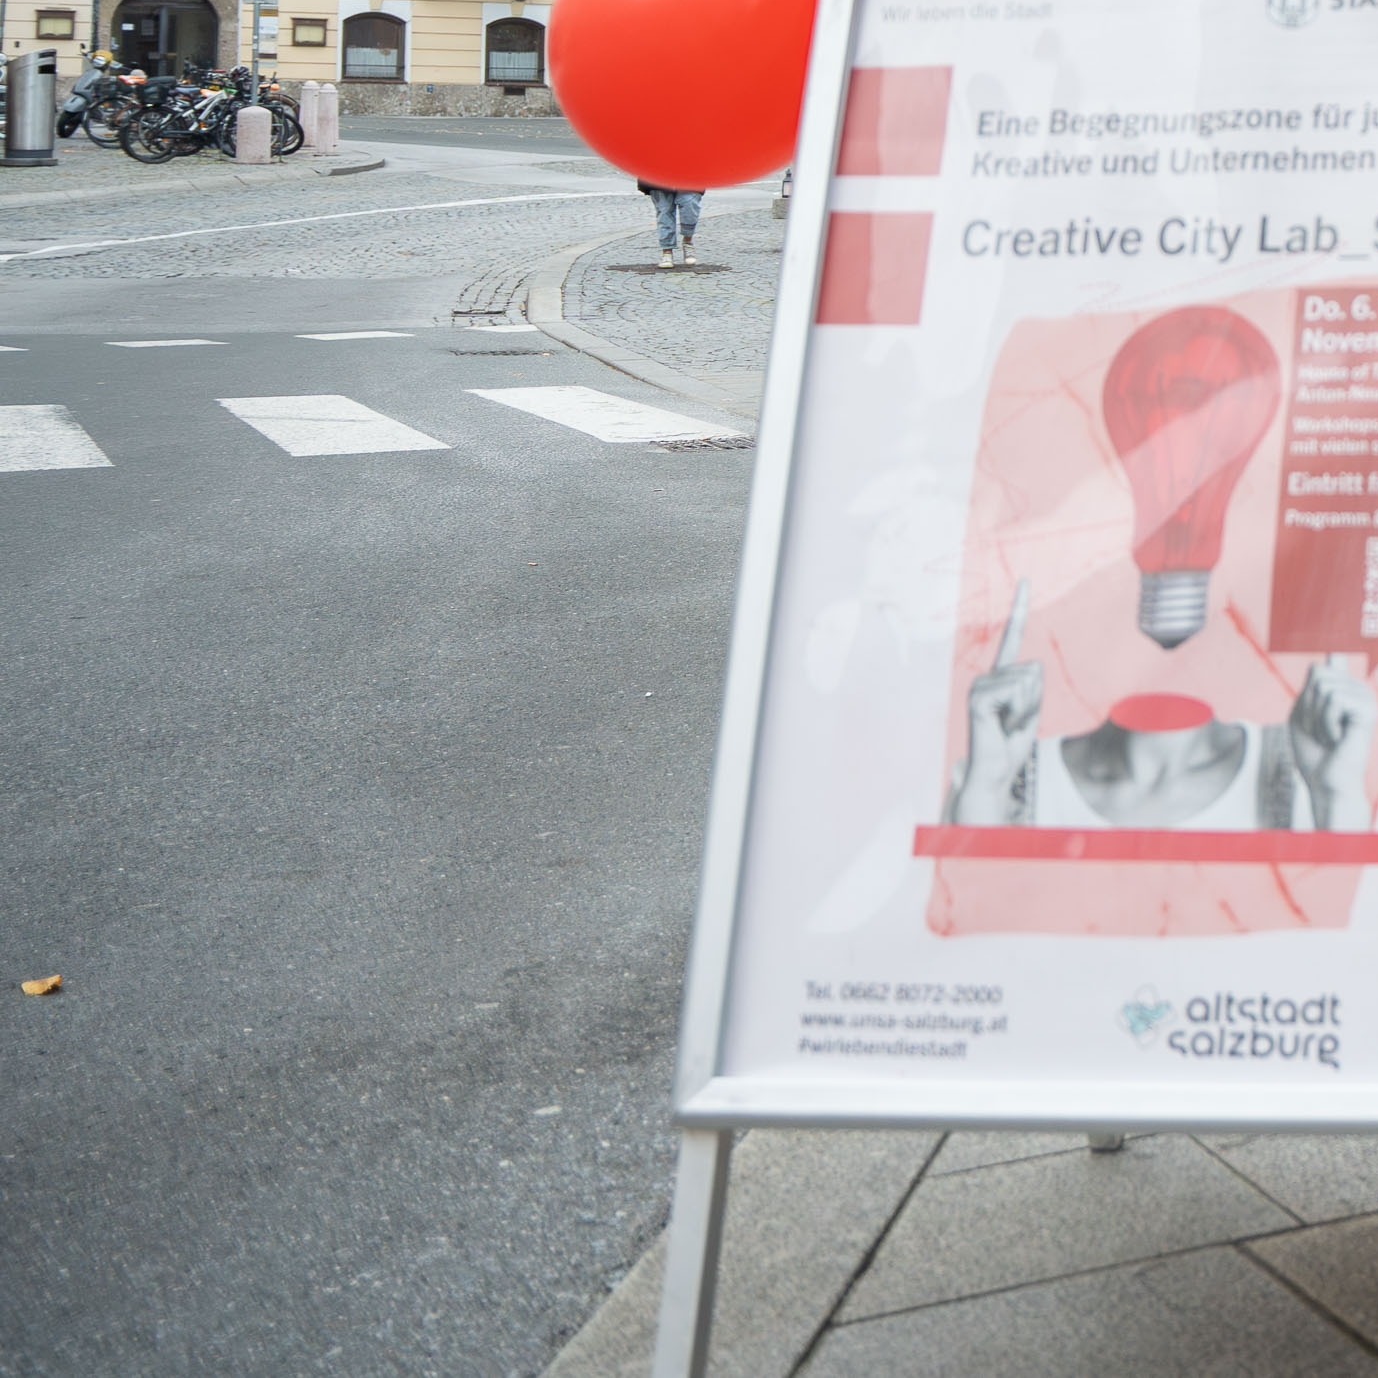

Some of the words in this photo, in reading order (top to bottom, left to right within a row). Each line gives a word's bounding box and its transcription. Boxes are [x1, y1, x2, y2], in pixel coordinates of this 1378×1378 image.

[976, 109, 1039, 138] Eine
[1049, 104, 1303, 140] Begegnungszone
[1311, 102, 1353, 131] für
[971, 149, 1093, 178] Kreative
[1101, 147, 1159, 176] und
[1169, 145, 1377, 175] Unternehmen
[962, 216, 1143, 259] Creative
[1157, 215, 1243, 263] City
[1303, 295, 1346, 321] Do.
[1350, 294, 1376, 320] 6.
[1186, 992, 1342, 1024] altstadt
[1167, 1025, 1342, 1069] salzburg
